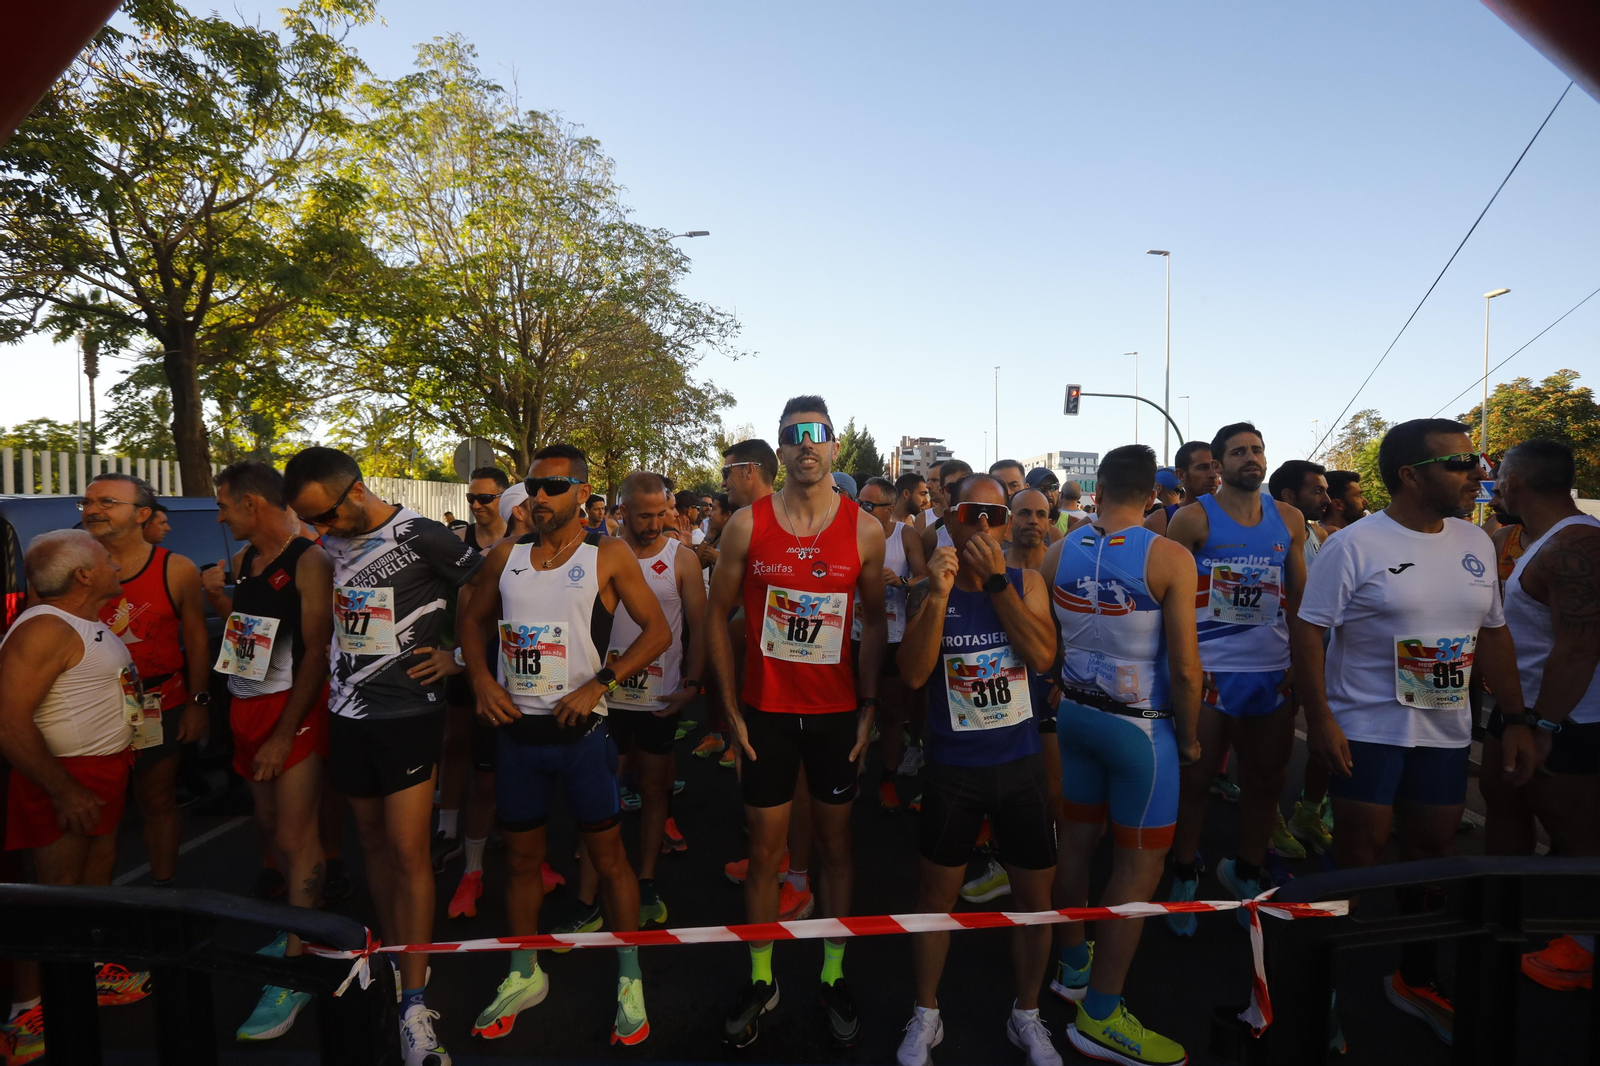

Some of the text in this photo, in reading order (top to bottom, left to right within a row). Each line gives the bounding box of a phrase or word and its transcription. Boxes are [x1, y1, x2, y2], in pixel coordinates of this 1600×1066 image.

[400, 543, 413, 557] AL
[377, 550, 421, 580] VELETA
[760, 563, 793, 573] califas
[1233, 586, 1263, 608] 132
[344, 611, 371, 635] 127
[787, 616, 823, 643] 187
[514, 649, 541, 674] 113
[1090, 651, 1105, 660] Club
[1433, 662, 1464, 688] 95
[971, 677, 1012, 708] 318
